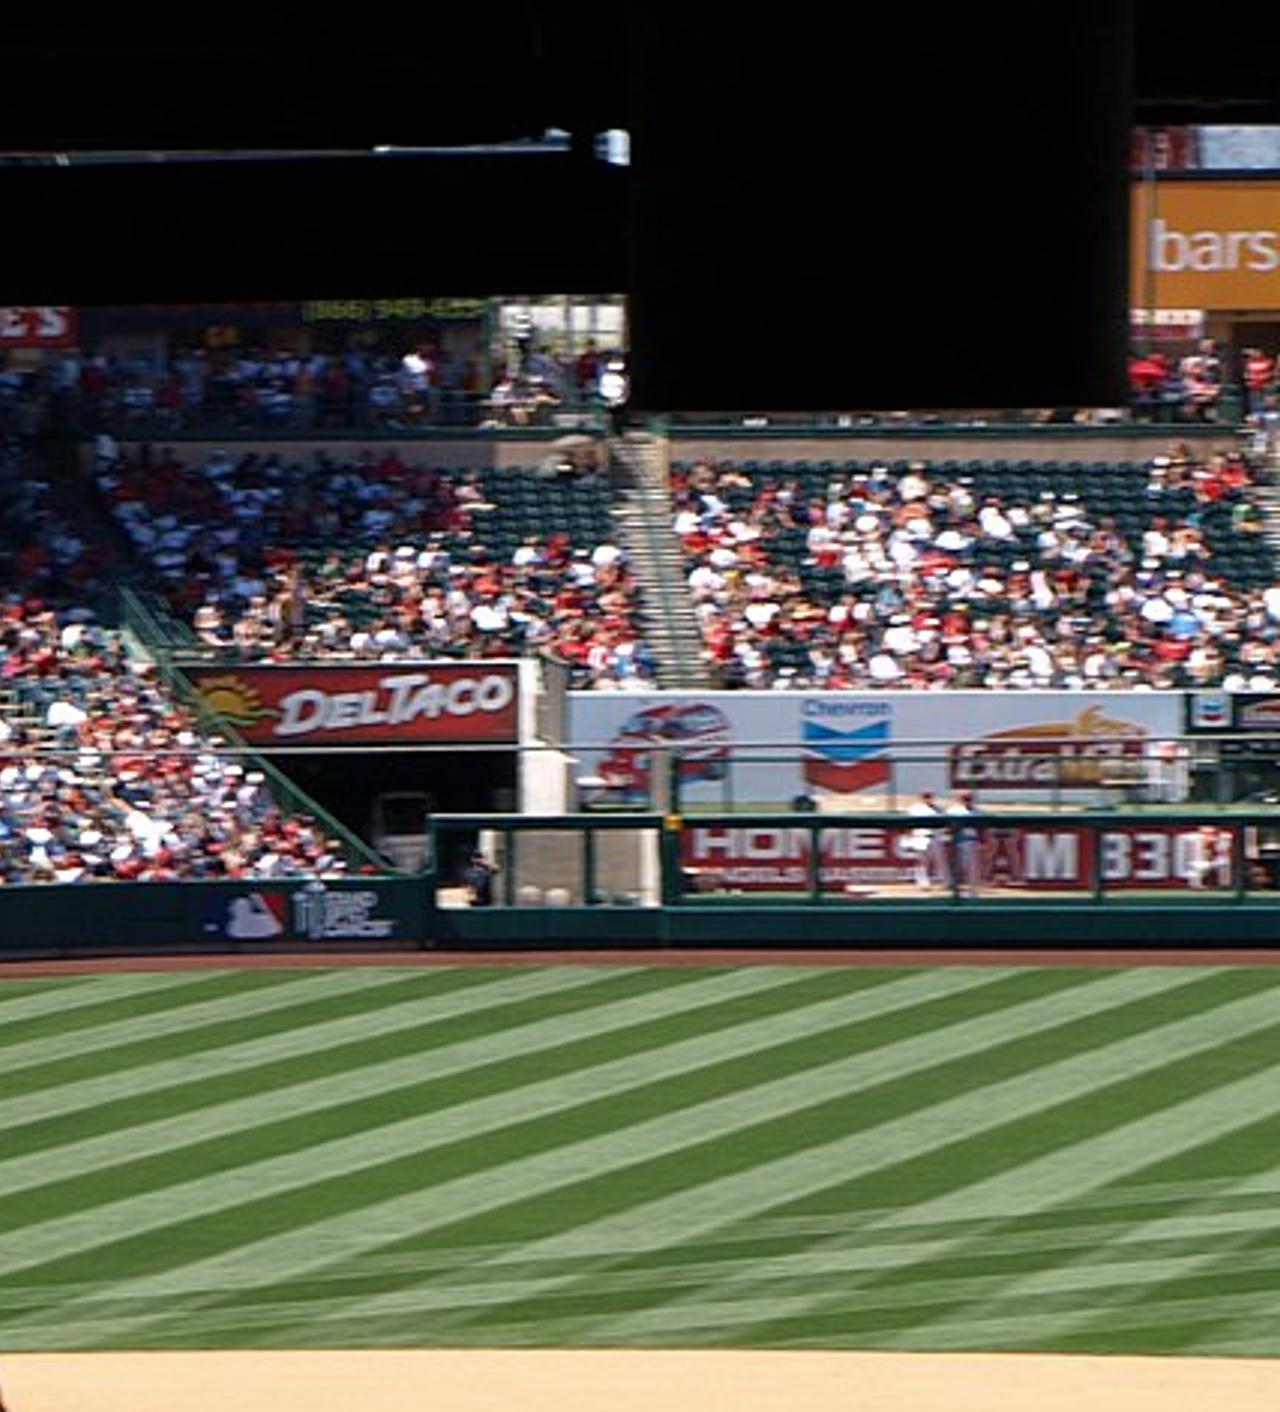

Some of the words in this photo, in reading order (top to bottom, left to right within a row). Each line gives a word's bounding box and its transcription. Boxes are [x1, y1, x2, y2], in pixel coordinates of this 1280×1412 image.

[1148, 218, 1279, 272] bars
[802, 699, 894, 718] Chevron
[692, 828, 887, 859] HOME
